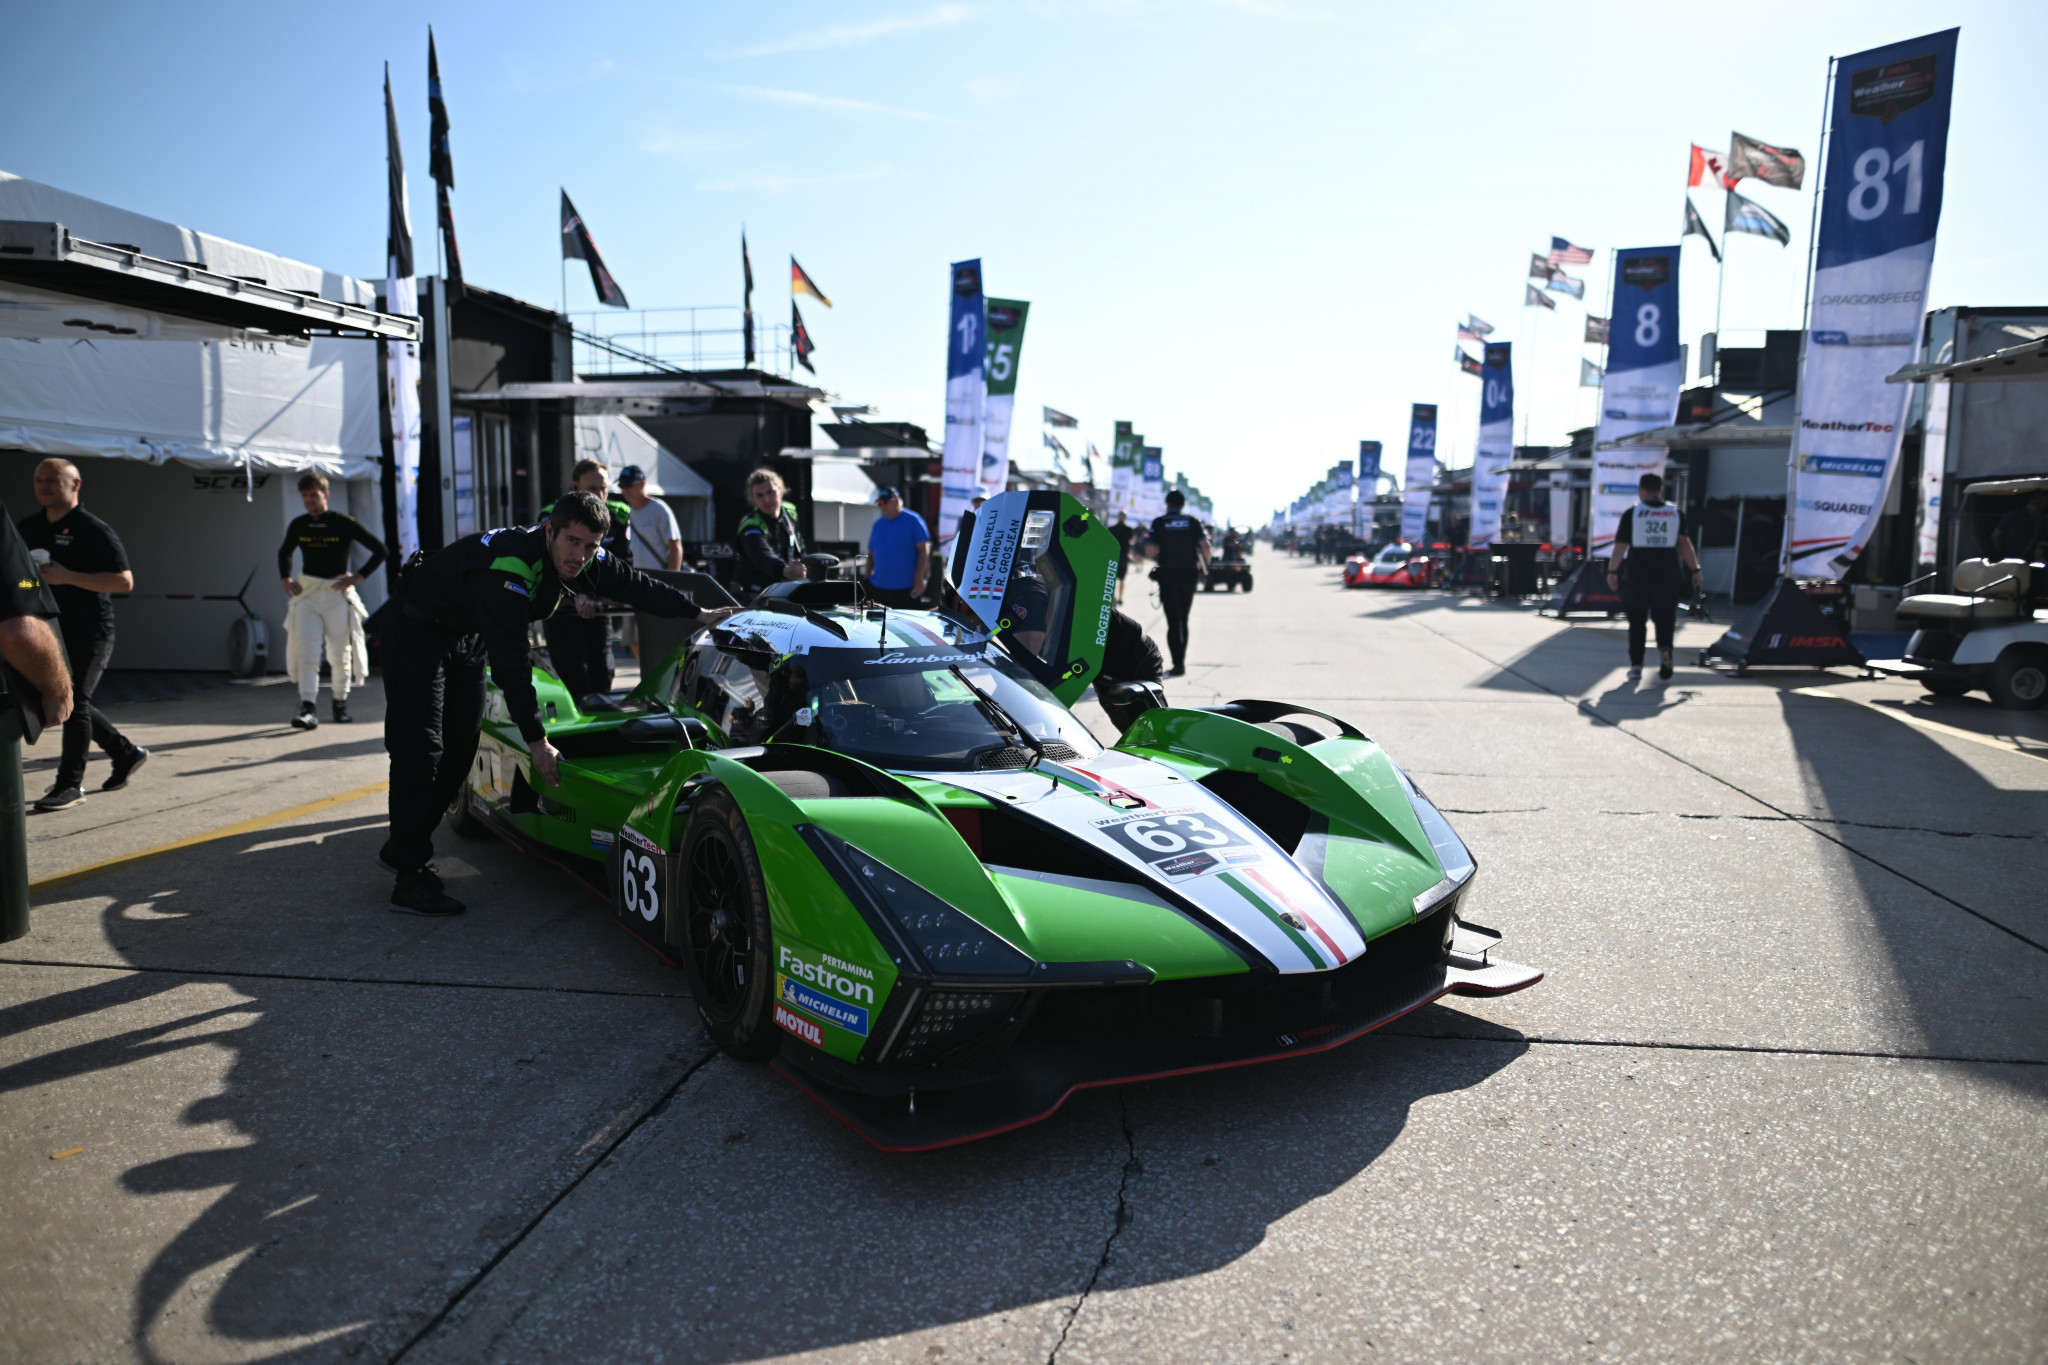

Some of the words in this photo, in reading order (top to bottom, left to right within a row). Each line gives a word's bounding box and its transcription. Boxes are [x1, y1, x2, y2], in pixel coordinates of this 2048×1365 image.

[1847, 139, 1925, 222] 81
[1820, 290, 1922, 306] DRAGONSPEED
[1634, 303, 1661, 348] 8
[1412, 427, 1435, 450] 22
[1820, 460, 1884, 474] MICHELIN
[976, 510, 999, 572] CALDARELLI
[999, 519, 1020, 574] GROSJEAN
[1645, 520, 1668, 535] 324
[701, 543, 734, 555] ERA
[986, 530, 1005, 572] CAIROLI
[1102, 560, 1118, 603] DUBUIS
[1095, 604, 1112, 647] ROGER
[1788, 635, 1847, 649] IMSA
[1094, 808, 1195, 826] WeatherTech
[1123, 815, 1230, 853] 63
[620, 826, 663, 855] WeatherTech
[623, 848, 659, 922] 63
[779, 945, 875, 1005] Fastron
[822, 953, 874, 981] PERTAMINA
[775, 1006, 822, 1045] MOTUL
[798, 993, 860, 1025] MICHELIN
